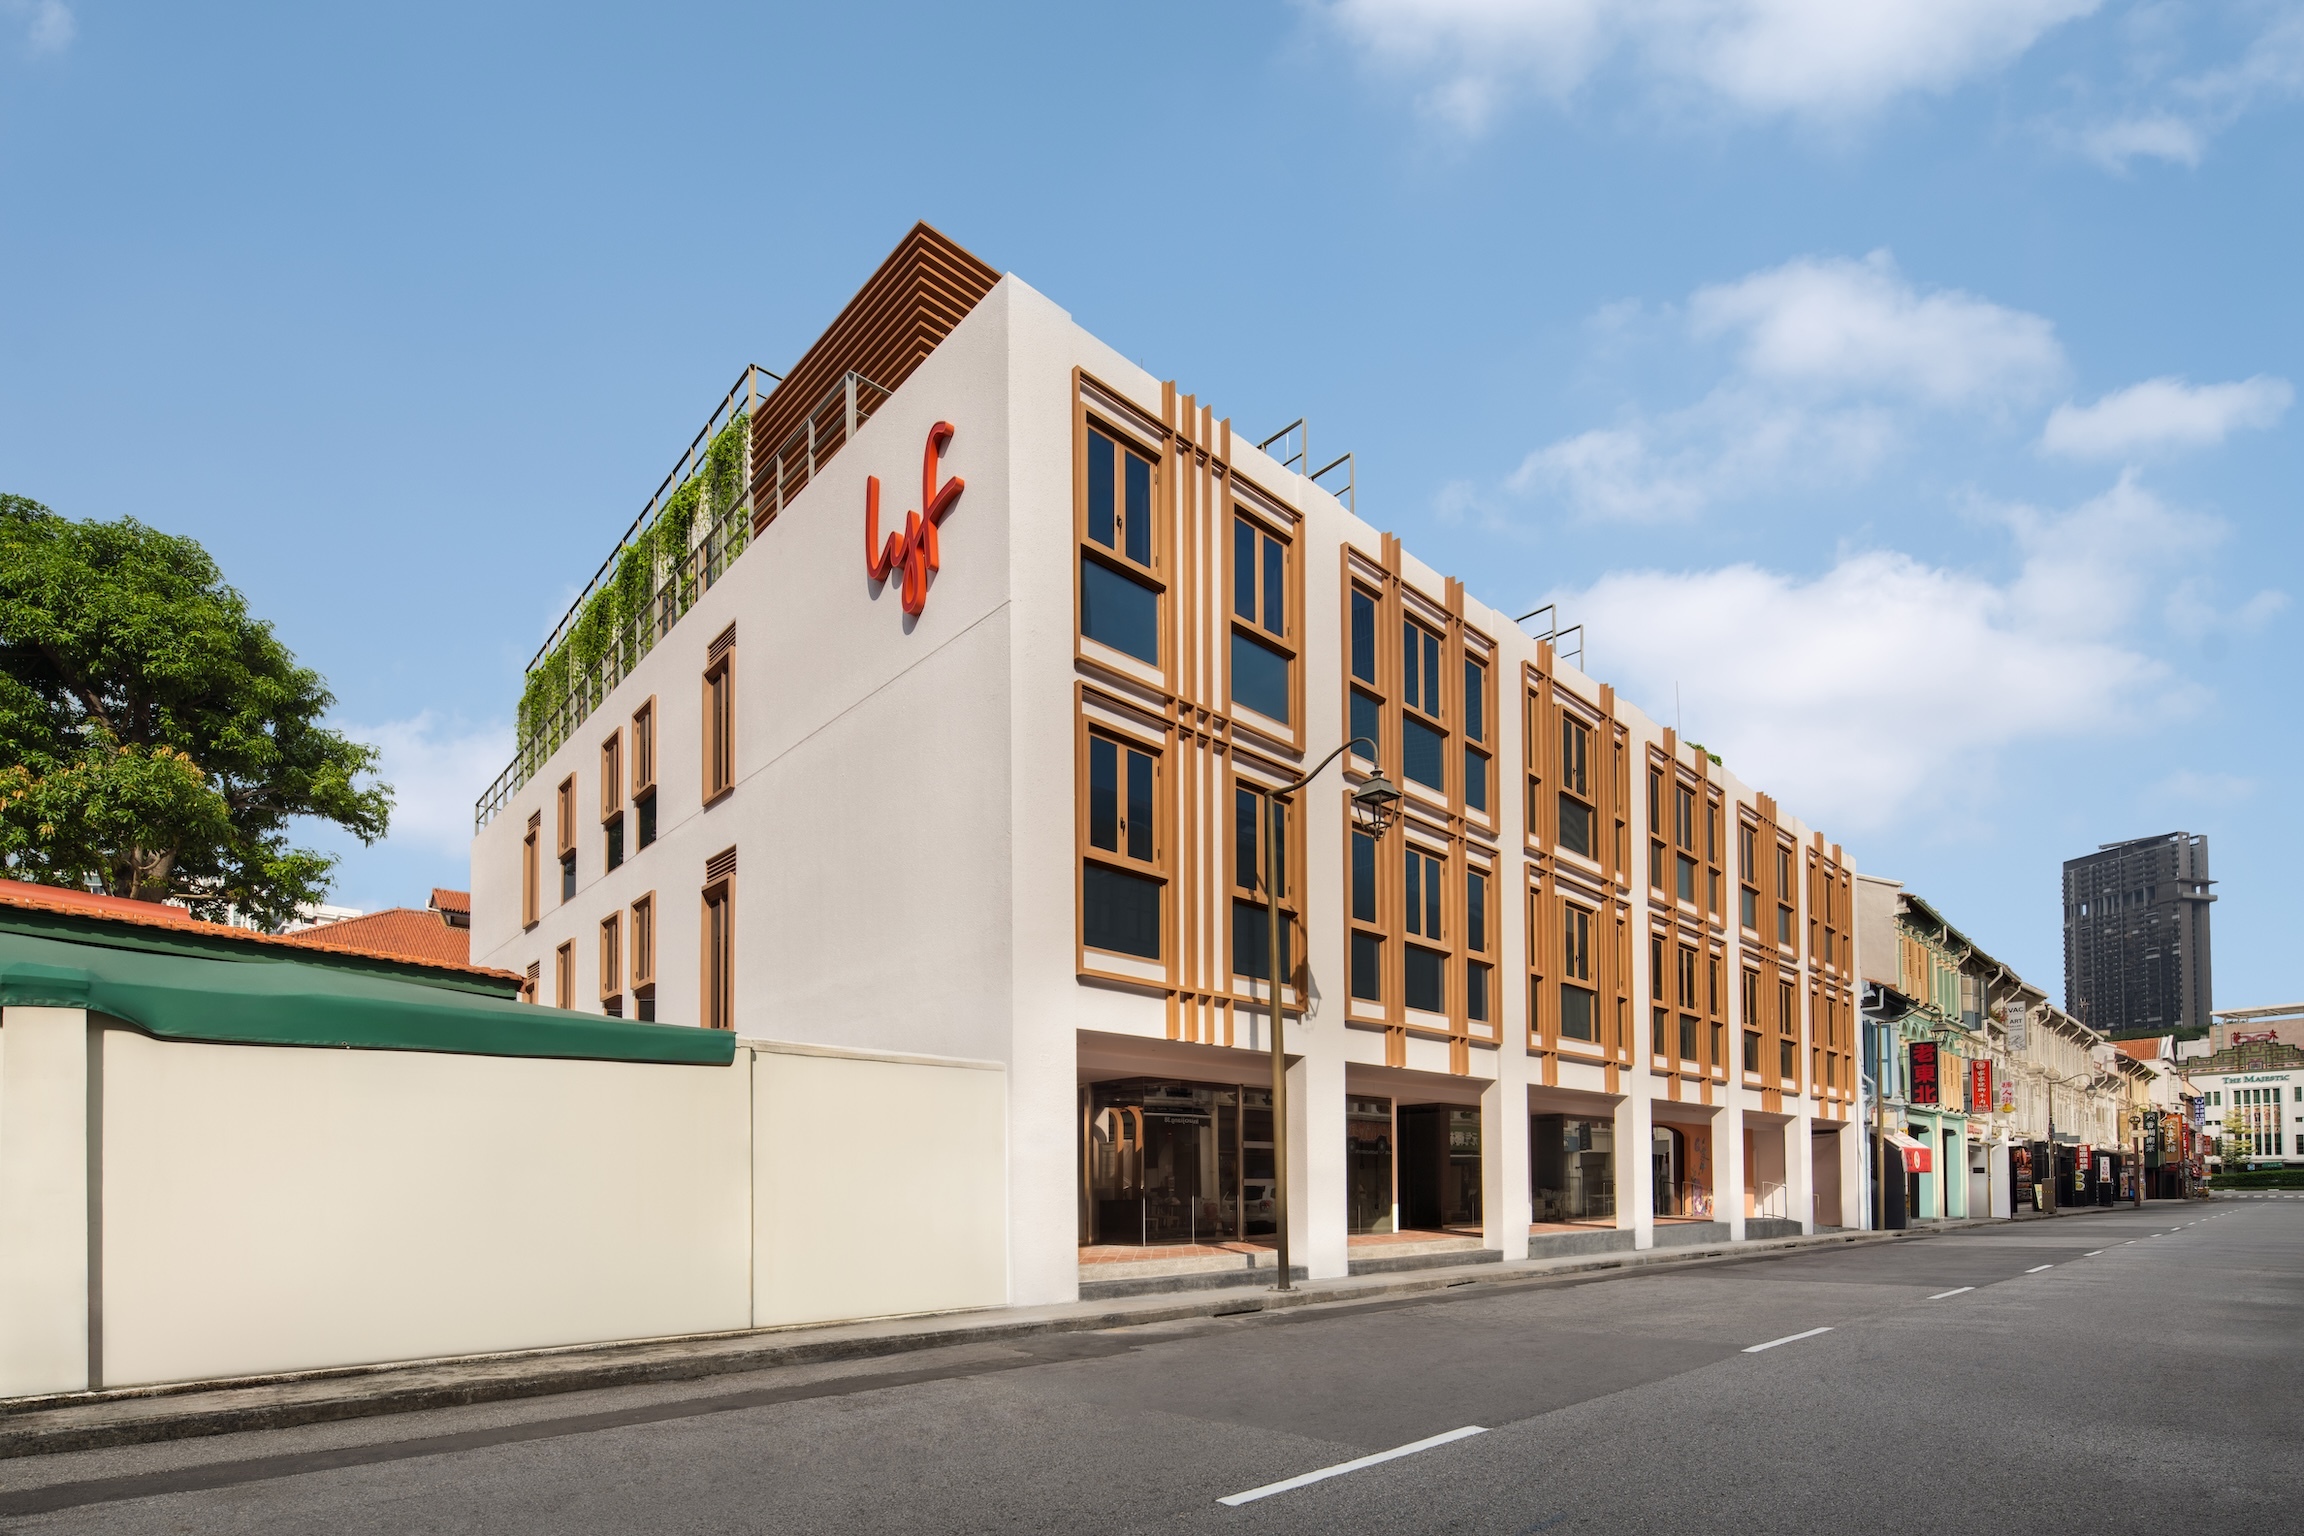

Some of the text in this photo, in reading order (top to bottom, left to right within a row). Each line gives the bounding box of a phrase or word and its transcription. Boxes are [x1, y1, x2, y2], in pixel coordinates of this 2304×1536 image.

[1913, 1043, 1937, 1104] 老東北
[2222, 1074, 2290, 1084] THE MAJESTIC
